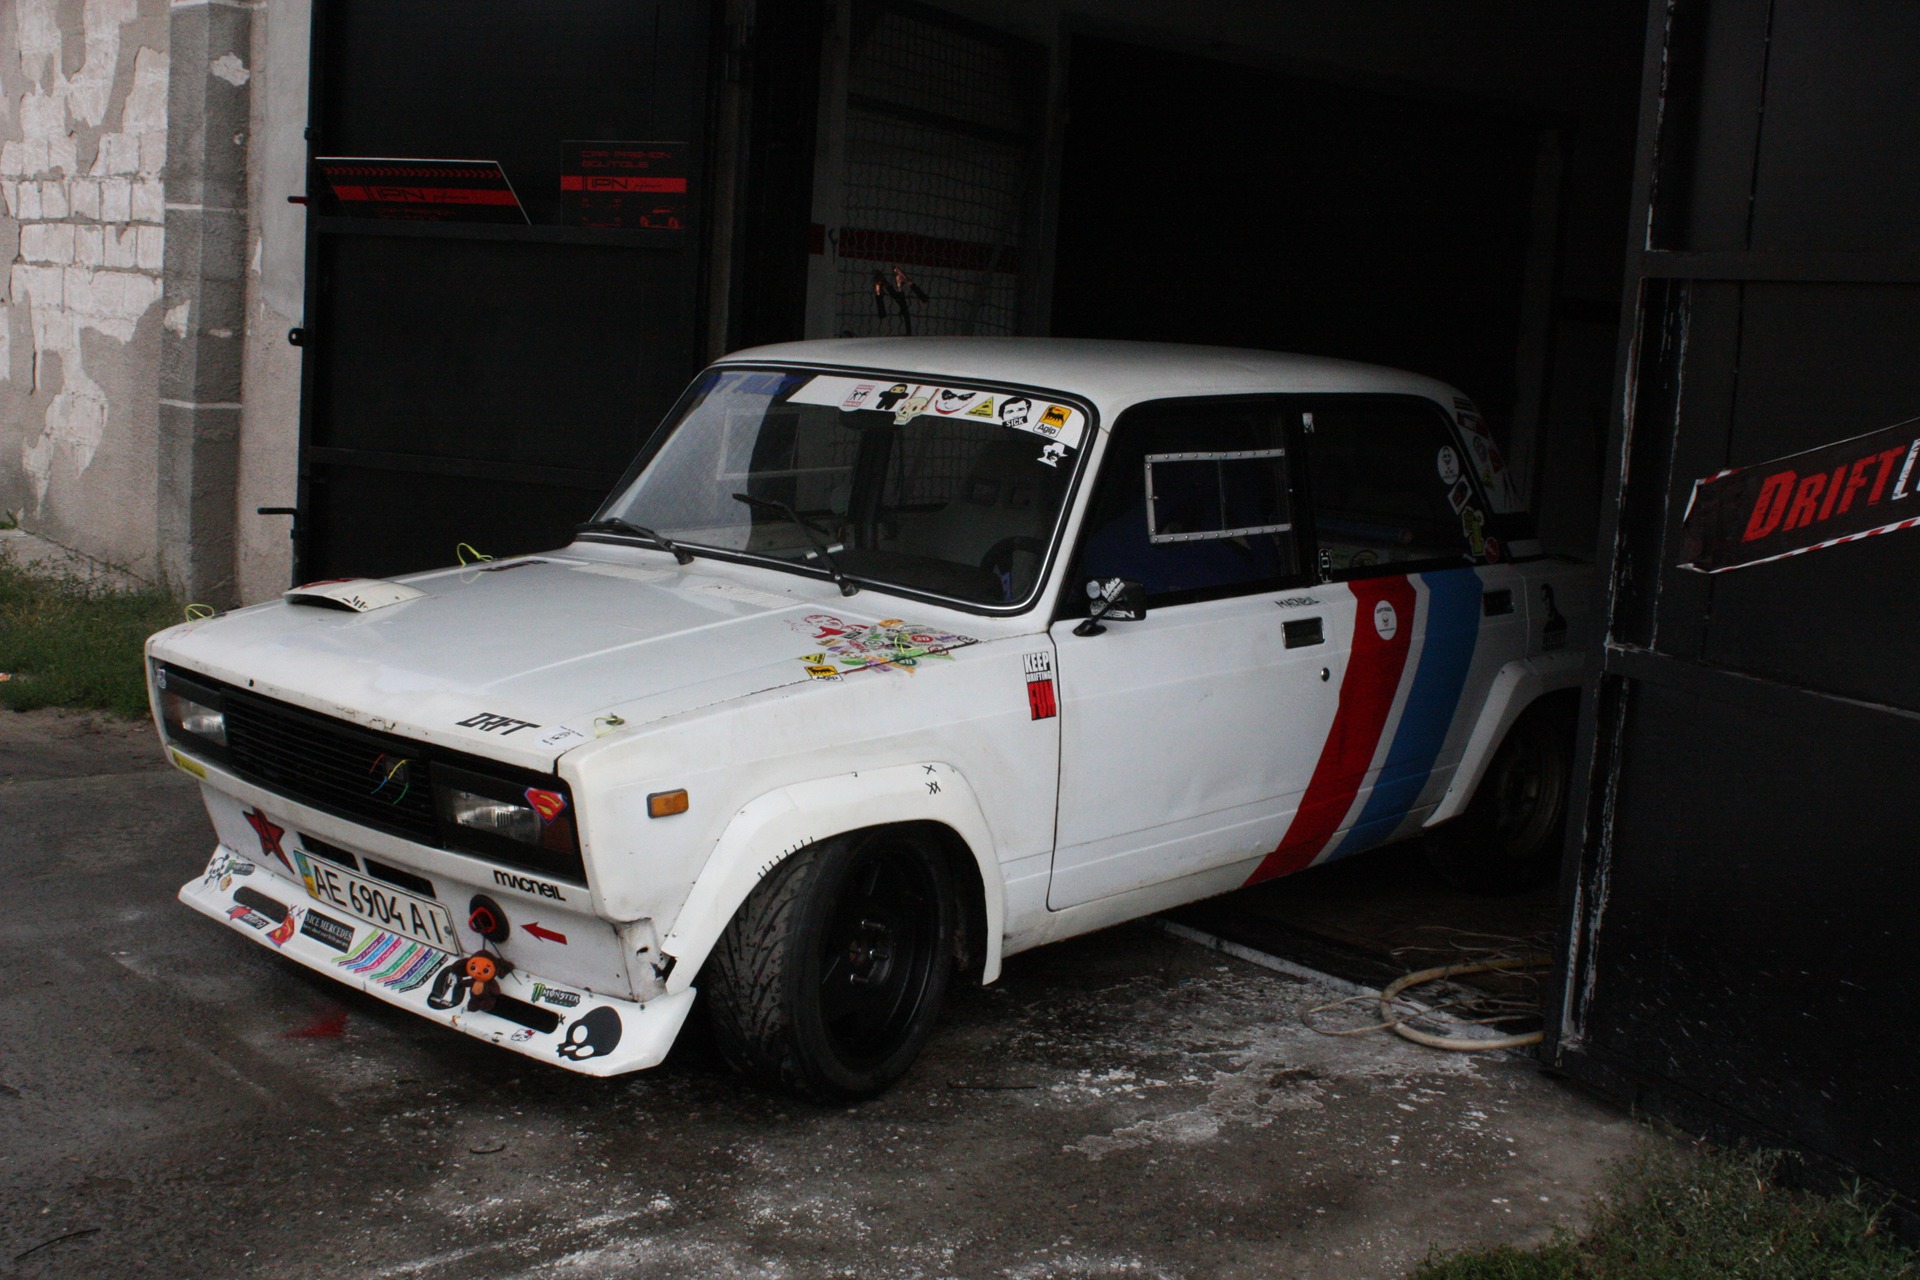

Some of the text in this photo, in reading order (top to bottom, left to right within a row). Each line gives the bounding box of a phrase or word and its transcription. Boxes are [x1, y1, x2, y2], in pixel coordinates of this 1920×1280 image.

[1005, 417, 1025, 428] SICK
[1037, 422, 1057, 435] Agip
[1023, 651, 1050, 673] KEEP
[1026, 670, 1052, 682] DRIFTING
[313, 864, 443, 945] AE 6904 AI
[306, 911, 321, 928] NICE
[320, 918, 352, 942] MERCEDES
[543, 989, 580, 1004] MONSTER
